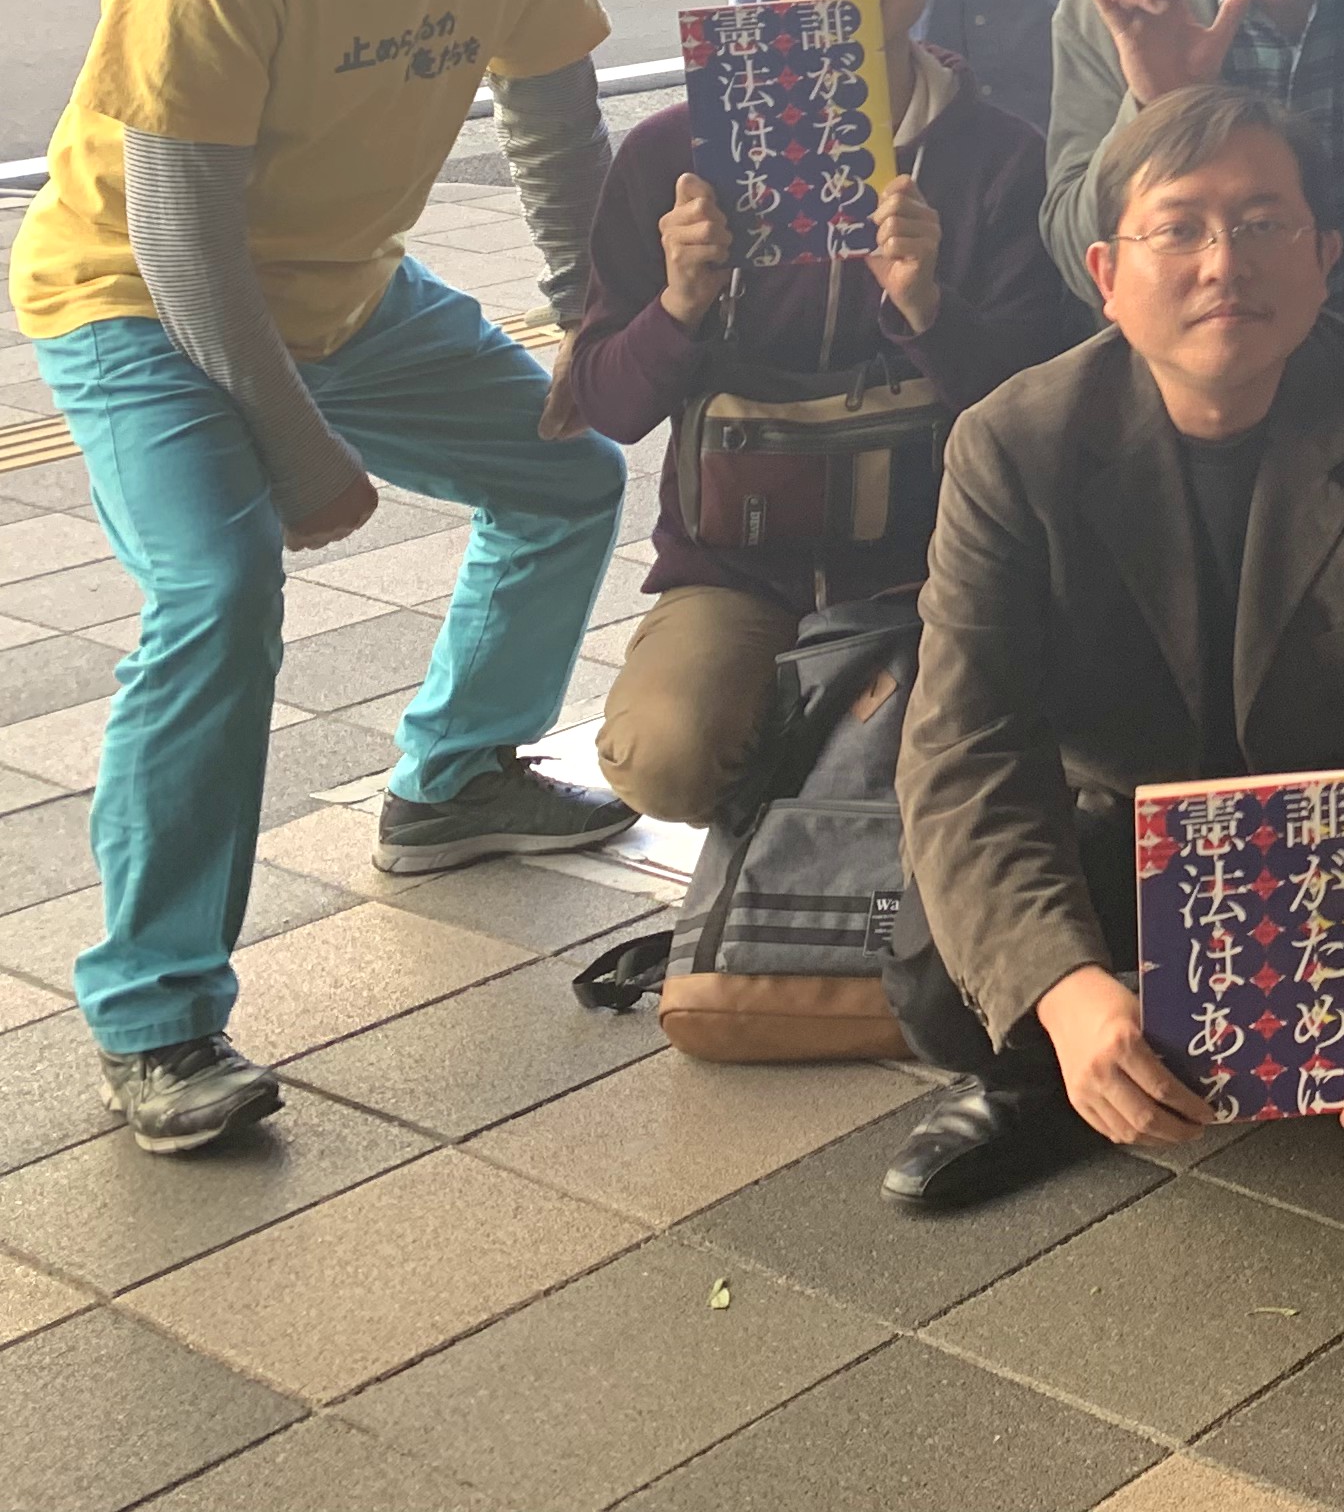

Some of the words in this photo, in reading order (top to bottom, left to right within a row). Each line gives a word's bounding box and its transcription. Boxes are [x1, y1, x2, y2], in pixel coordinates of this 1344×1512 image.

[711, 5, 782, 269] 憲法はある
[800, 0, 873, 261] 誰がために
[1178, 792, 1252, 1125] 憲法はある
